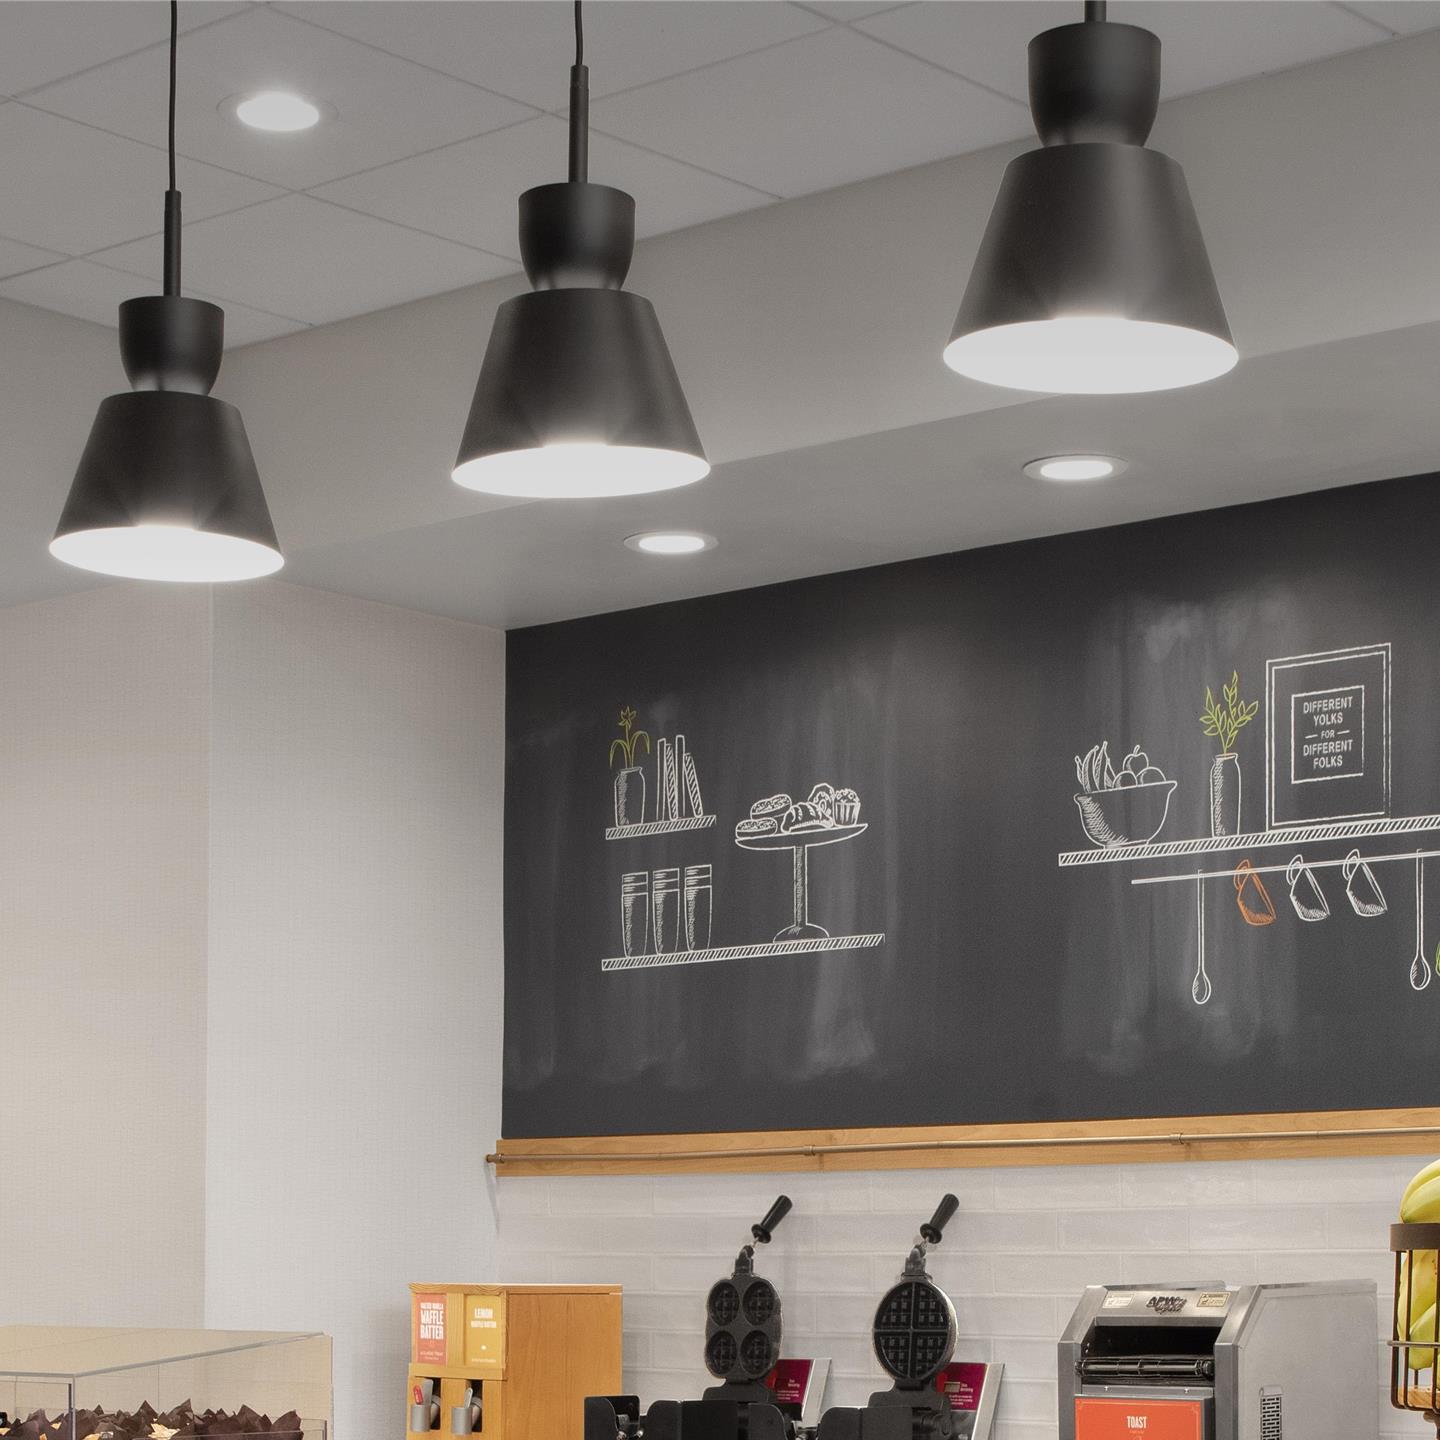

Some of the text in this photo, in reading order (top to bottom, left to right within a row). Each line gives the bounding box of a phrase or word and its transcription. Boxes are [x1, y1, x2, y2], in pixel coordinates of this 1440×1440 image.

[1303, 696, 1353, 715] DIFFERENT
[1313, 711, 1344, 727] YOLKS
[1320, 729, 1335, 740] FOR
[1303, 739, 1354, 757] DIFFERENT
[1313, 755, 1344, 770] FOLKS
[420, 1310, 444, 1325] WAFFLE
[420, 1324, 444, 1340] BATTER
[1127, 1416, 1147, 1428] TOAST
